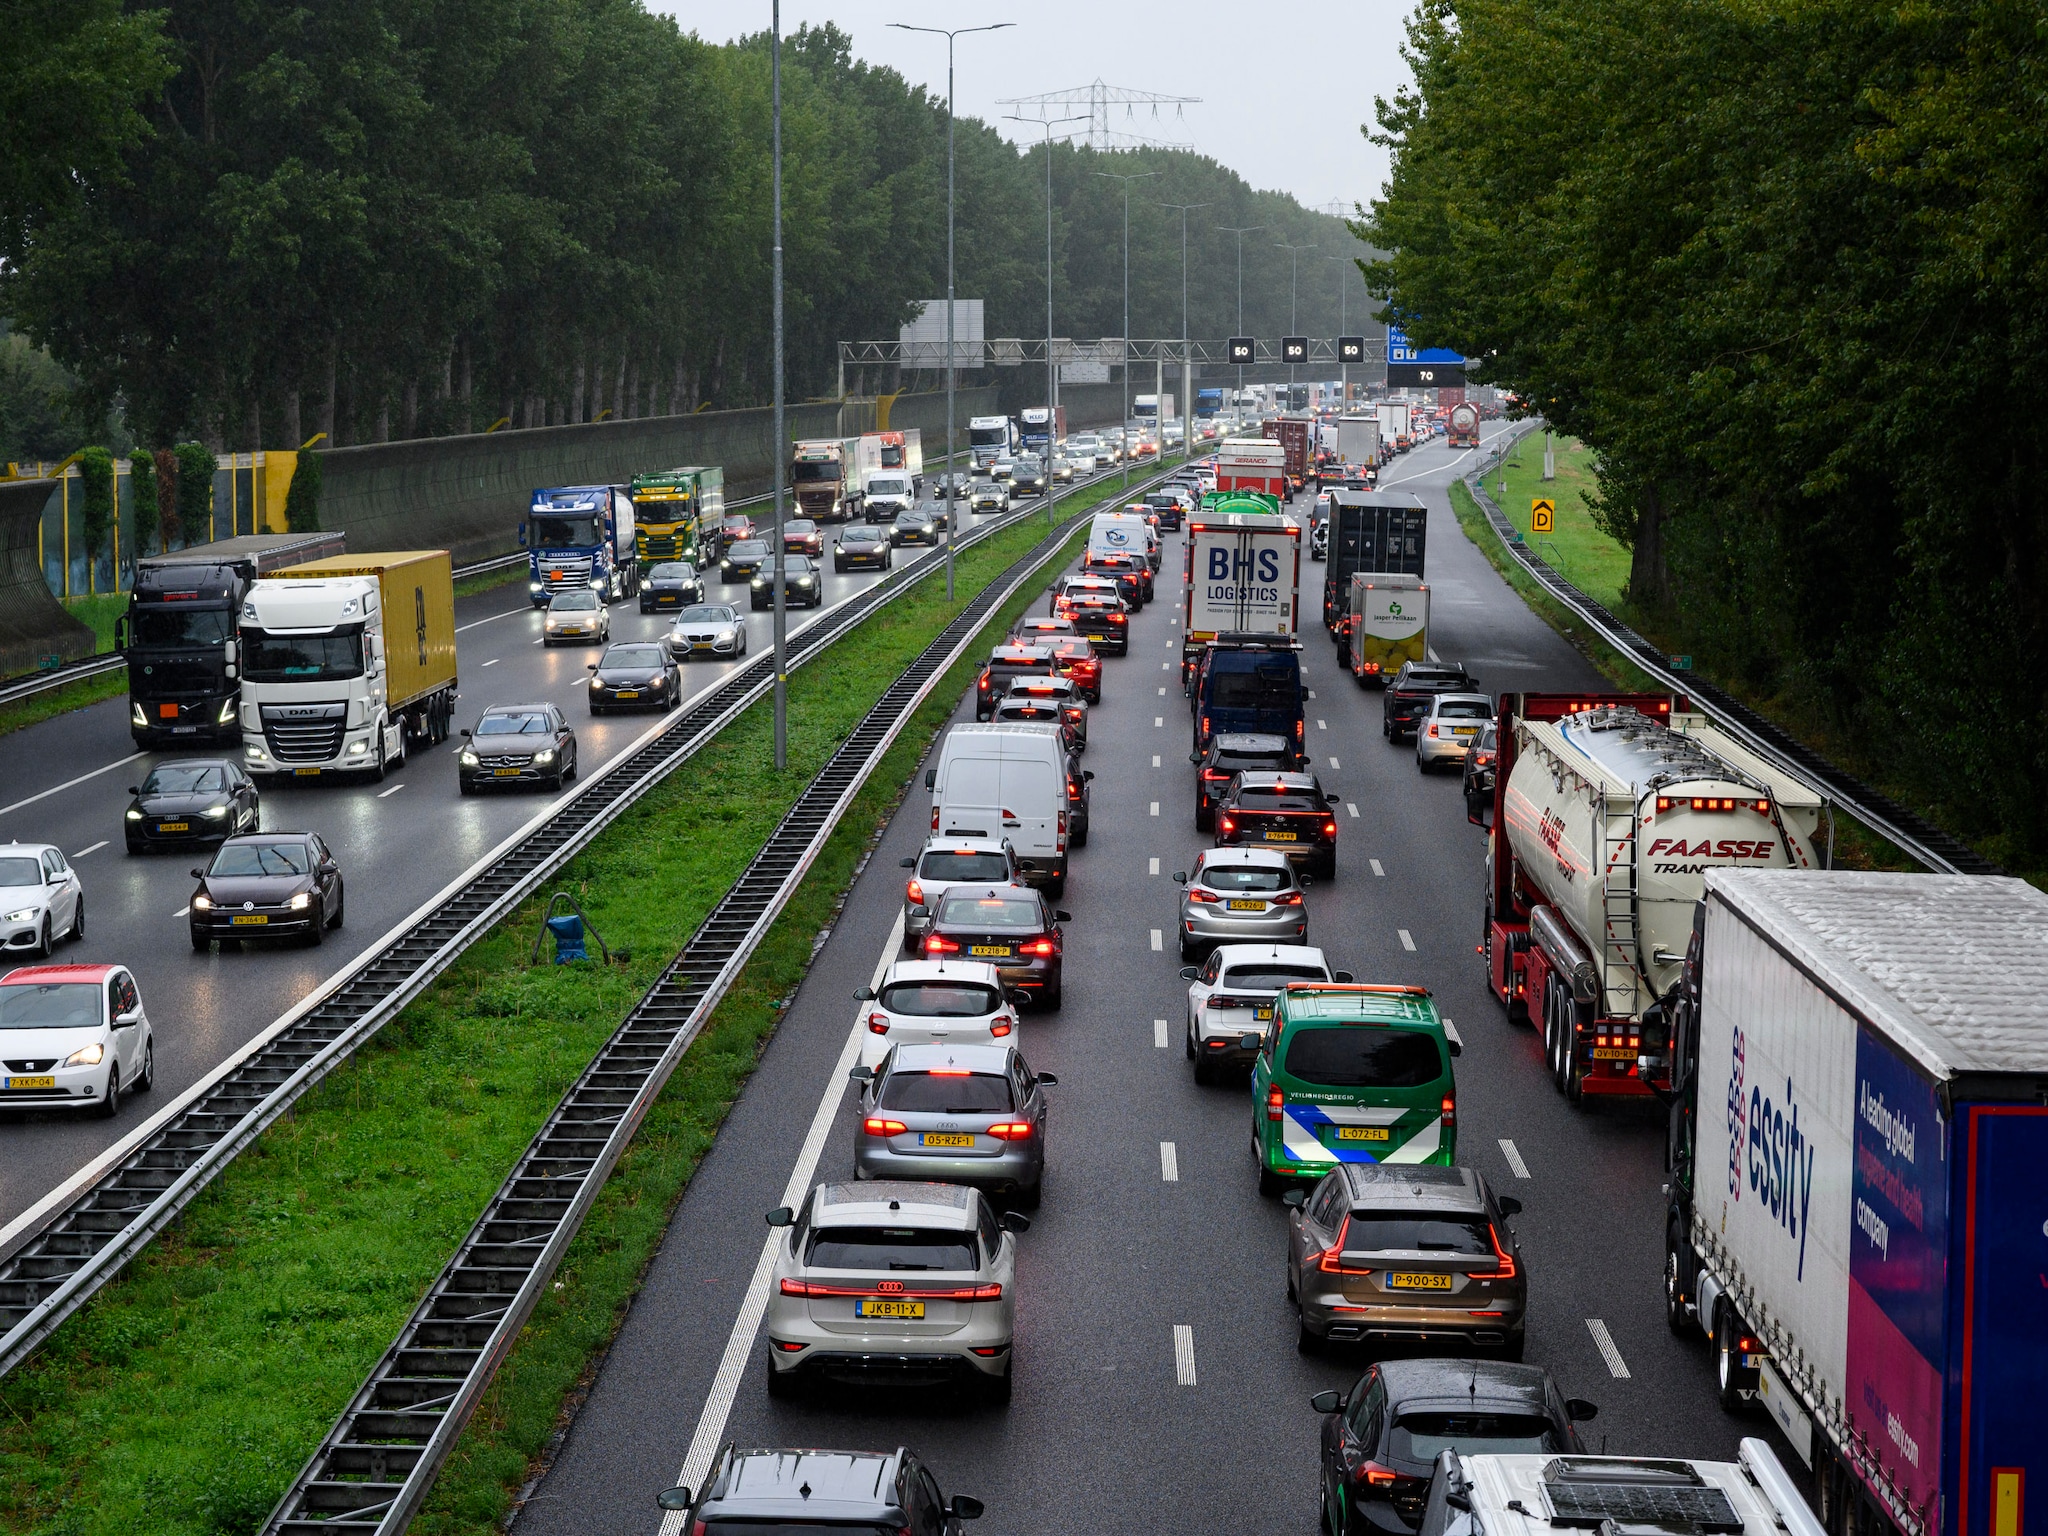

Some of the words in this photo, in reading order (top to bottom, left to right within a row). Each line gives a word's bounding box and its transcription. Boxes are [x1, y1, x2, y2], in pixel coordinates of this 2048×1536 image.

[1234, 346, 1249, 356] 50
[1288, 346, 1302, 355] 50
[1344, 345, 1358, 355] 50
[1420, 371, 1434, 380] 70
[1537, 513, 1548, 526] D
[1208, 547, 1279, 583] BHS
[1207, 586, 1278, 602] LOGISTICS
[1647, 839, 1775, 859] FAASSE
[1860, 1079, 1866, 1118] A
[1866, 1082, 1892, 1151] leading
[1892, 1109, 1915, 1165] global
[928, 1135, 969, 1145] 05-RZF-1
[1342, 1129, 1384, 1139] L-072-FL
[1749, 1076, 1814, 1283] essity
[1856, 1197, 1889, 1262] company
[1395, 1275, 1447, 1287] P-900-SX
[869, 1304, 917, 1315] JKB-11-X
[1887, 1411, 1919, 1469] essity.com
